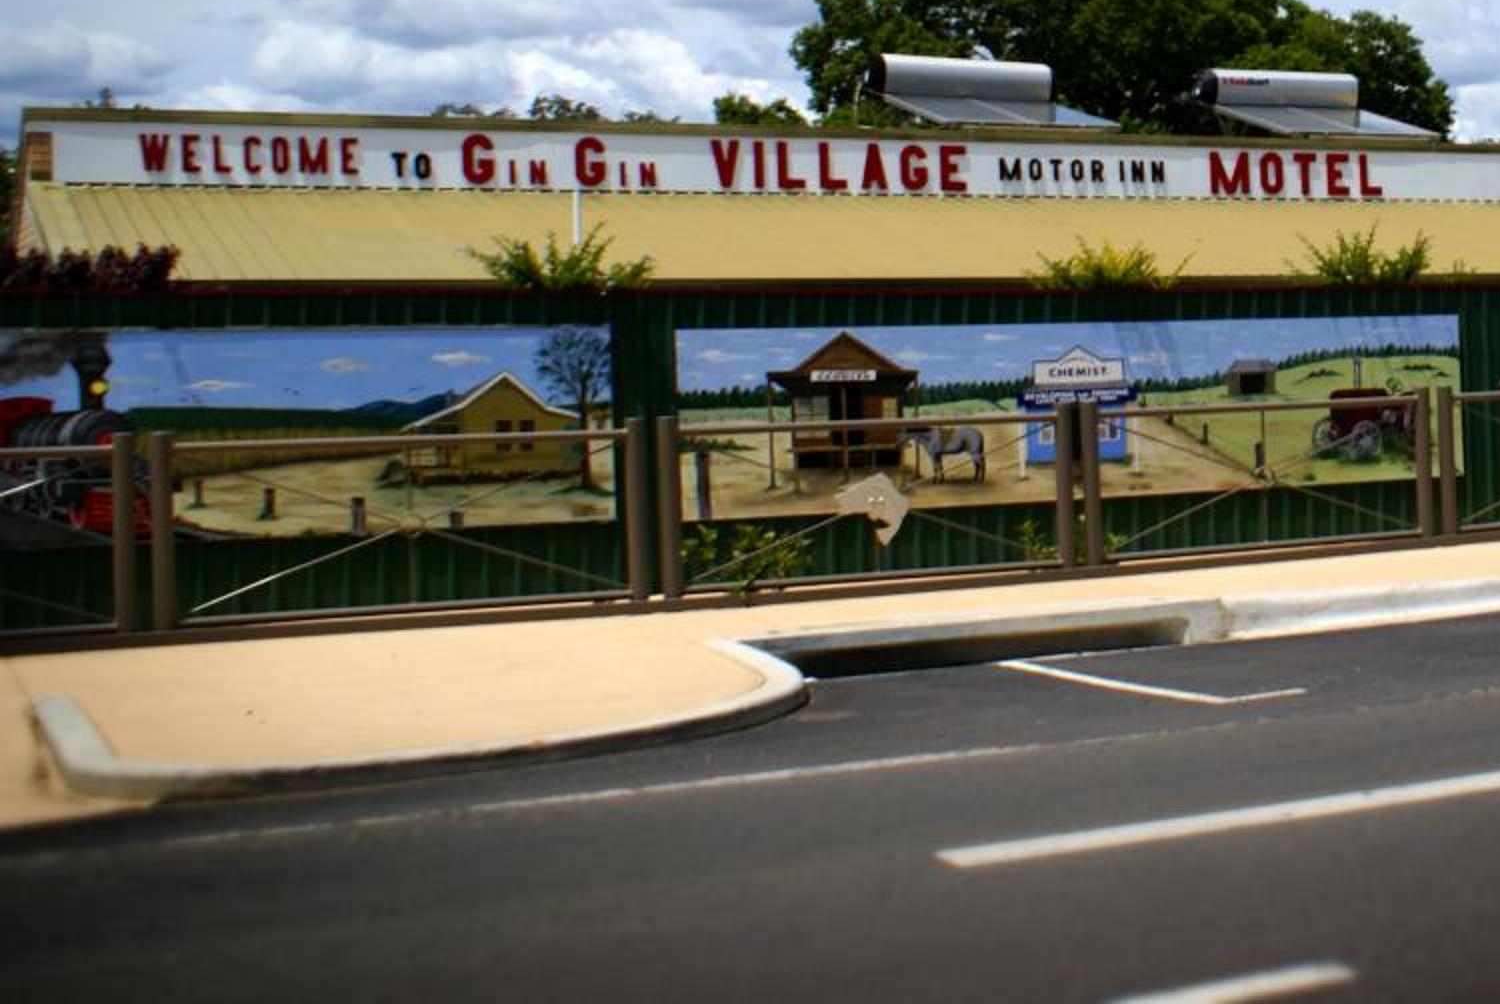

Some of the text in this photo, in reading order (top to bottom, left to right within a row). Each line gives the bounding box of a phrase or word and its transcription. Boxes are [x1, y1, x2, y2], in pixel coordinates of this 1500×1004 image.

[139, 134, 359, 175] WELCOME
[391, 151, 432, 180] TO
[710, 139, 968, 192] VILLAGE
[998, 158, 1105, 184] MOTOR
[1118, 160, 1166, 186] INN
[1209, 151, 1383, 196] MOTEL
[1048, 366, 1107, 377] CHEMIST
